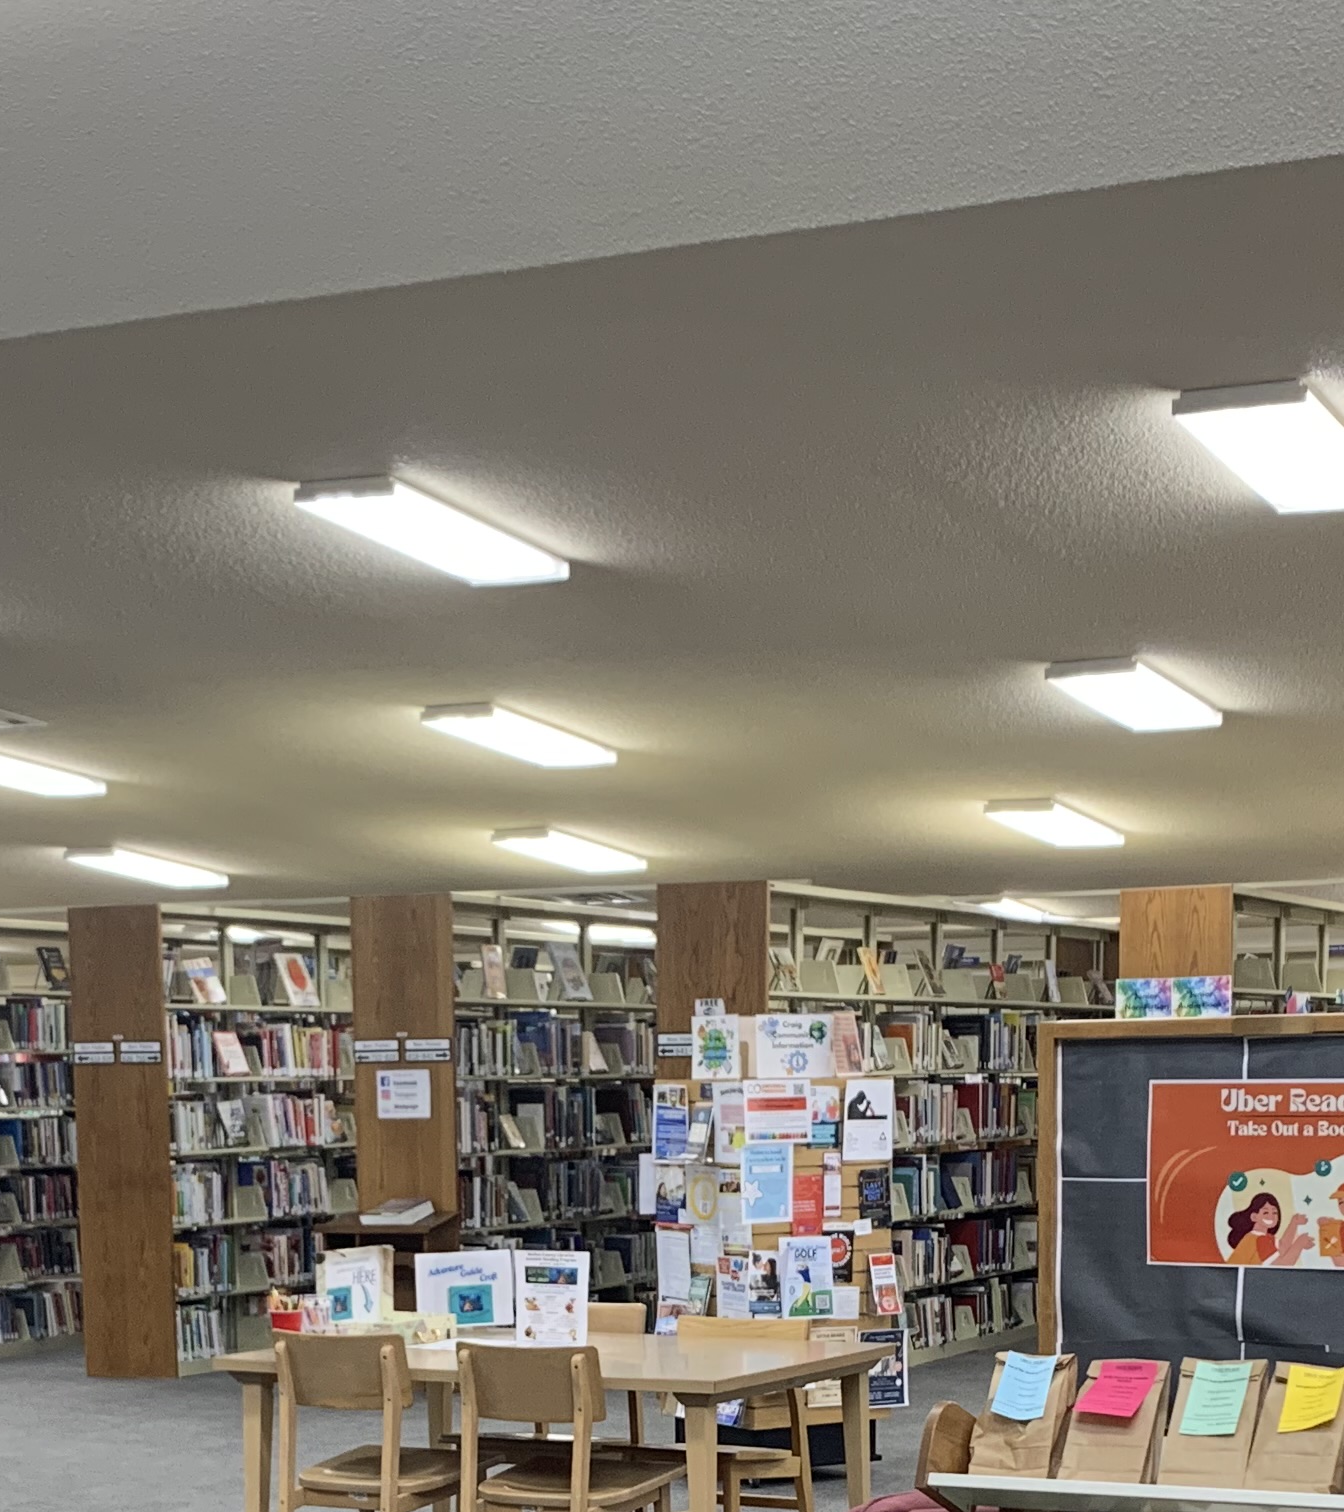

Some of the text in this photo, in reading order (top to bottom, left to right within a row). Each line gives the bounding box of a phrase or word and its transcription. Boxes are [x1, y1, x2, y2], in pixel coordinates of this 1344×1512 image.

[782, 1021, 802, 1029] Craig
[1220, 1088, 1284, 1112] Uber
[1227, 1120, 1268, 1136] Take
[1271, 1120, 1300, 1136] Out
[1302, 1123, 1314, 1136] a
[794, 1248, 816, 1258] GOLF
